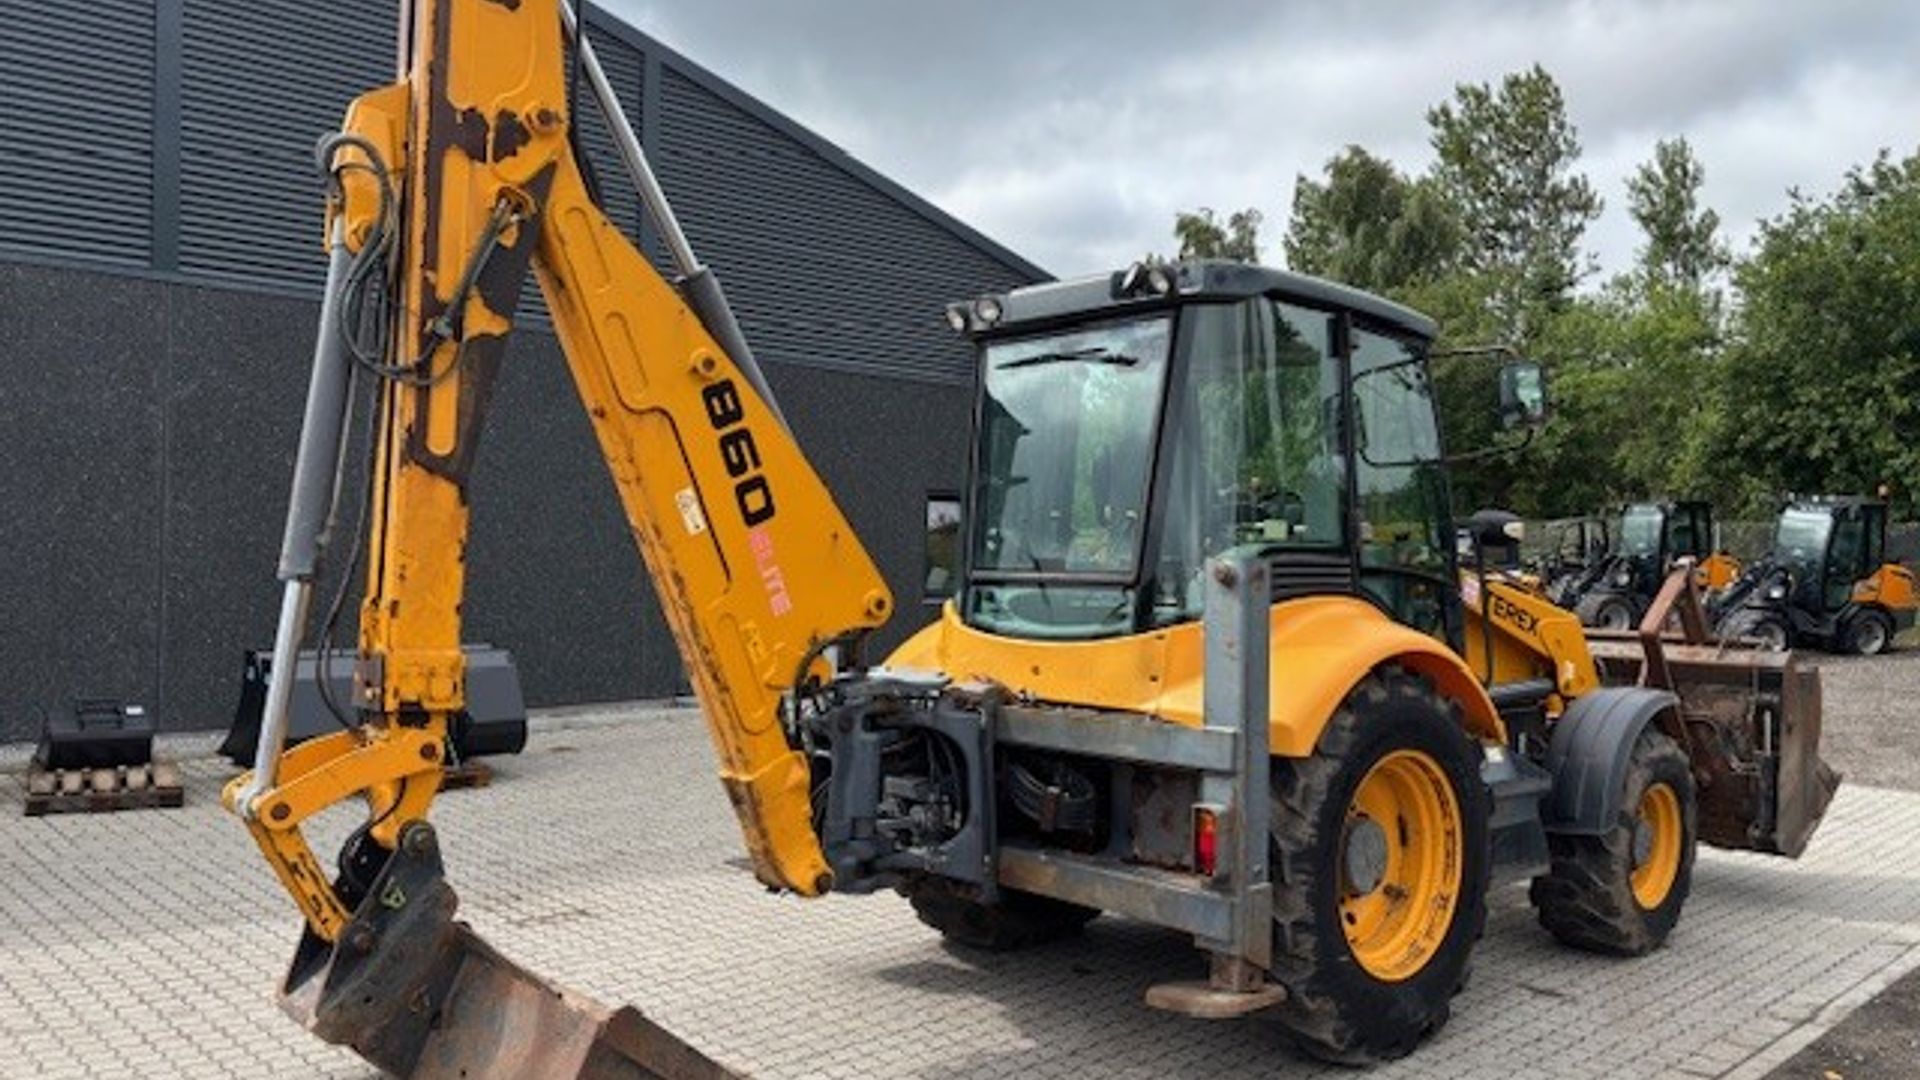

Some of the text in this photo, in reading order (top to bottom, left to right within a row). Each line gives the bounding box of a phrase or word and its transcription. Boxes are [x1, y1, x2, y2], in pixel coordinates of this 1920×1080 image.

[702, 378, 793, 618] 860 ELITE
[1488, 592, 1540, 637] EREX
